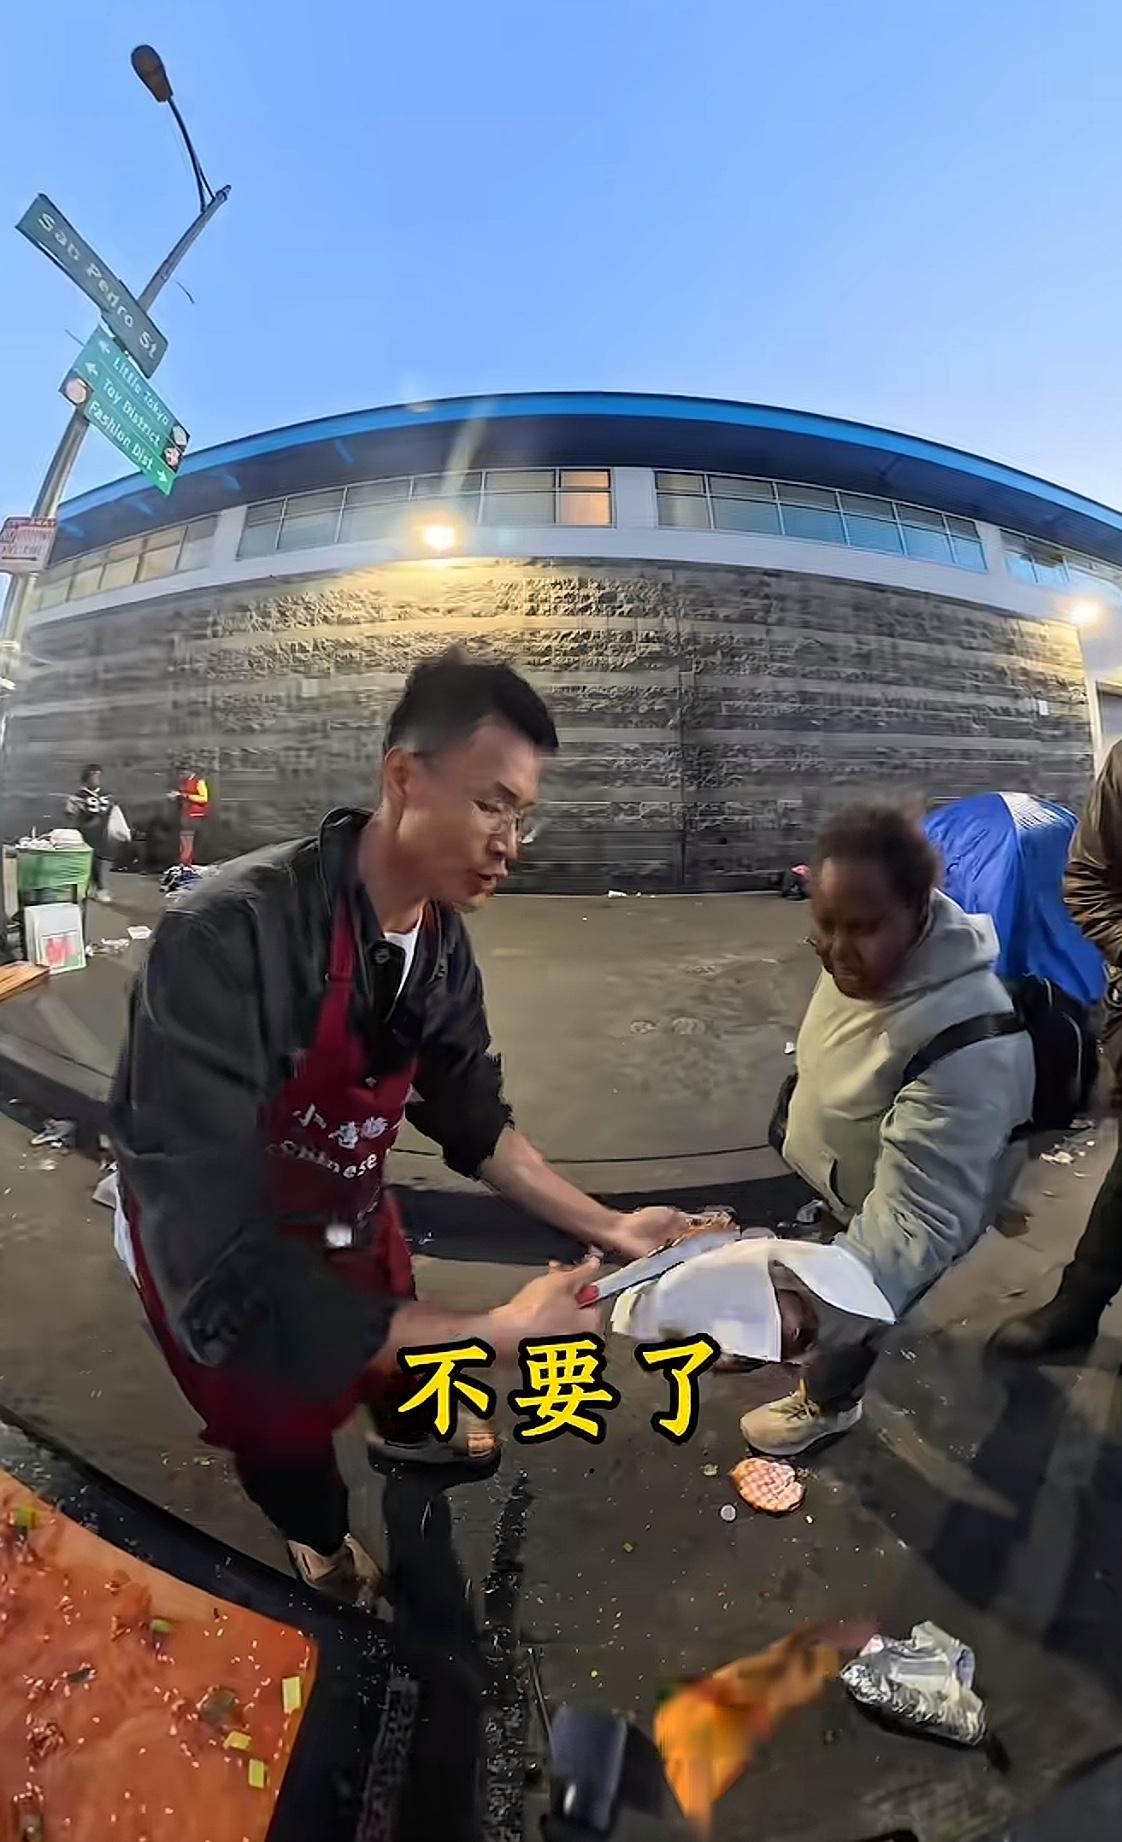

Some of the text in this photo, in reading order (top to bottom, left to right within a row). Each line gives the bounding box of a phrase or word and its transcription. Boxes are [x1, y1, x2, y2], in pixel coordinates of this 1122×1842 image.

[38, 212, 157, 359] San Pedro St
[102, 379, 161, 447] Toy District
[112, 357, 170, 426] Little Tokyo
[87, 401, 154, 470] Fashion Dist
